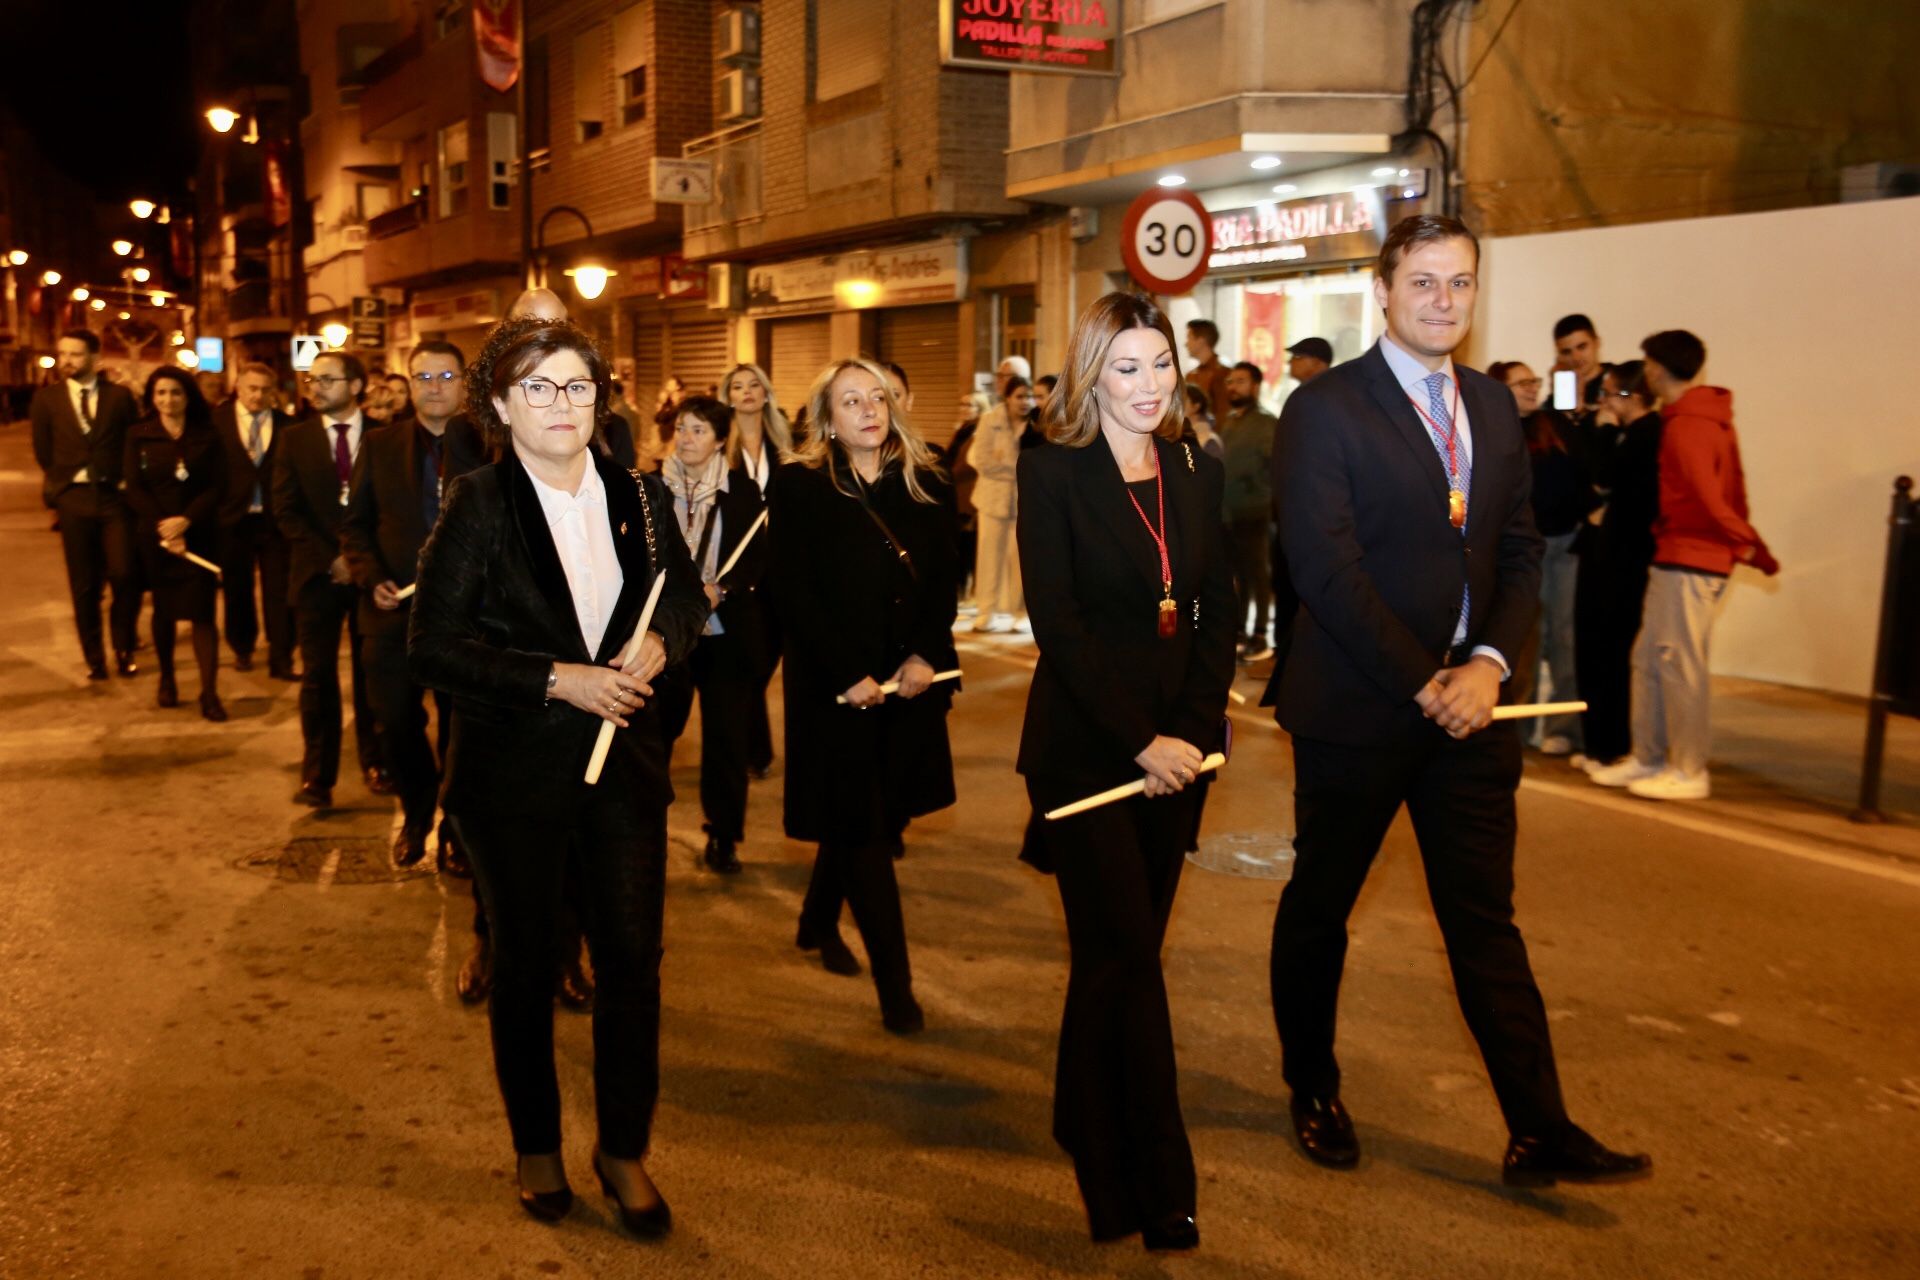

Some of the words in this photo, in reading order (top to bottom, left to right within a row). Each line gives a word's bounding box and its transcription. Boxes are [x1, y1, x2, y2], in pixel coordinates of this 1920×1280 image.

[959, 19, 1043, 46] PADILLA
[1256, 200, 1373, 243] PADILLA
[1145, 222, 1196, 257] 30
